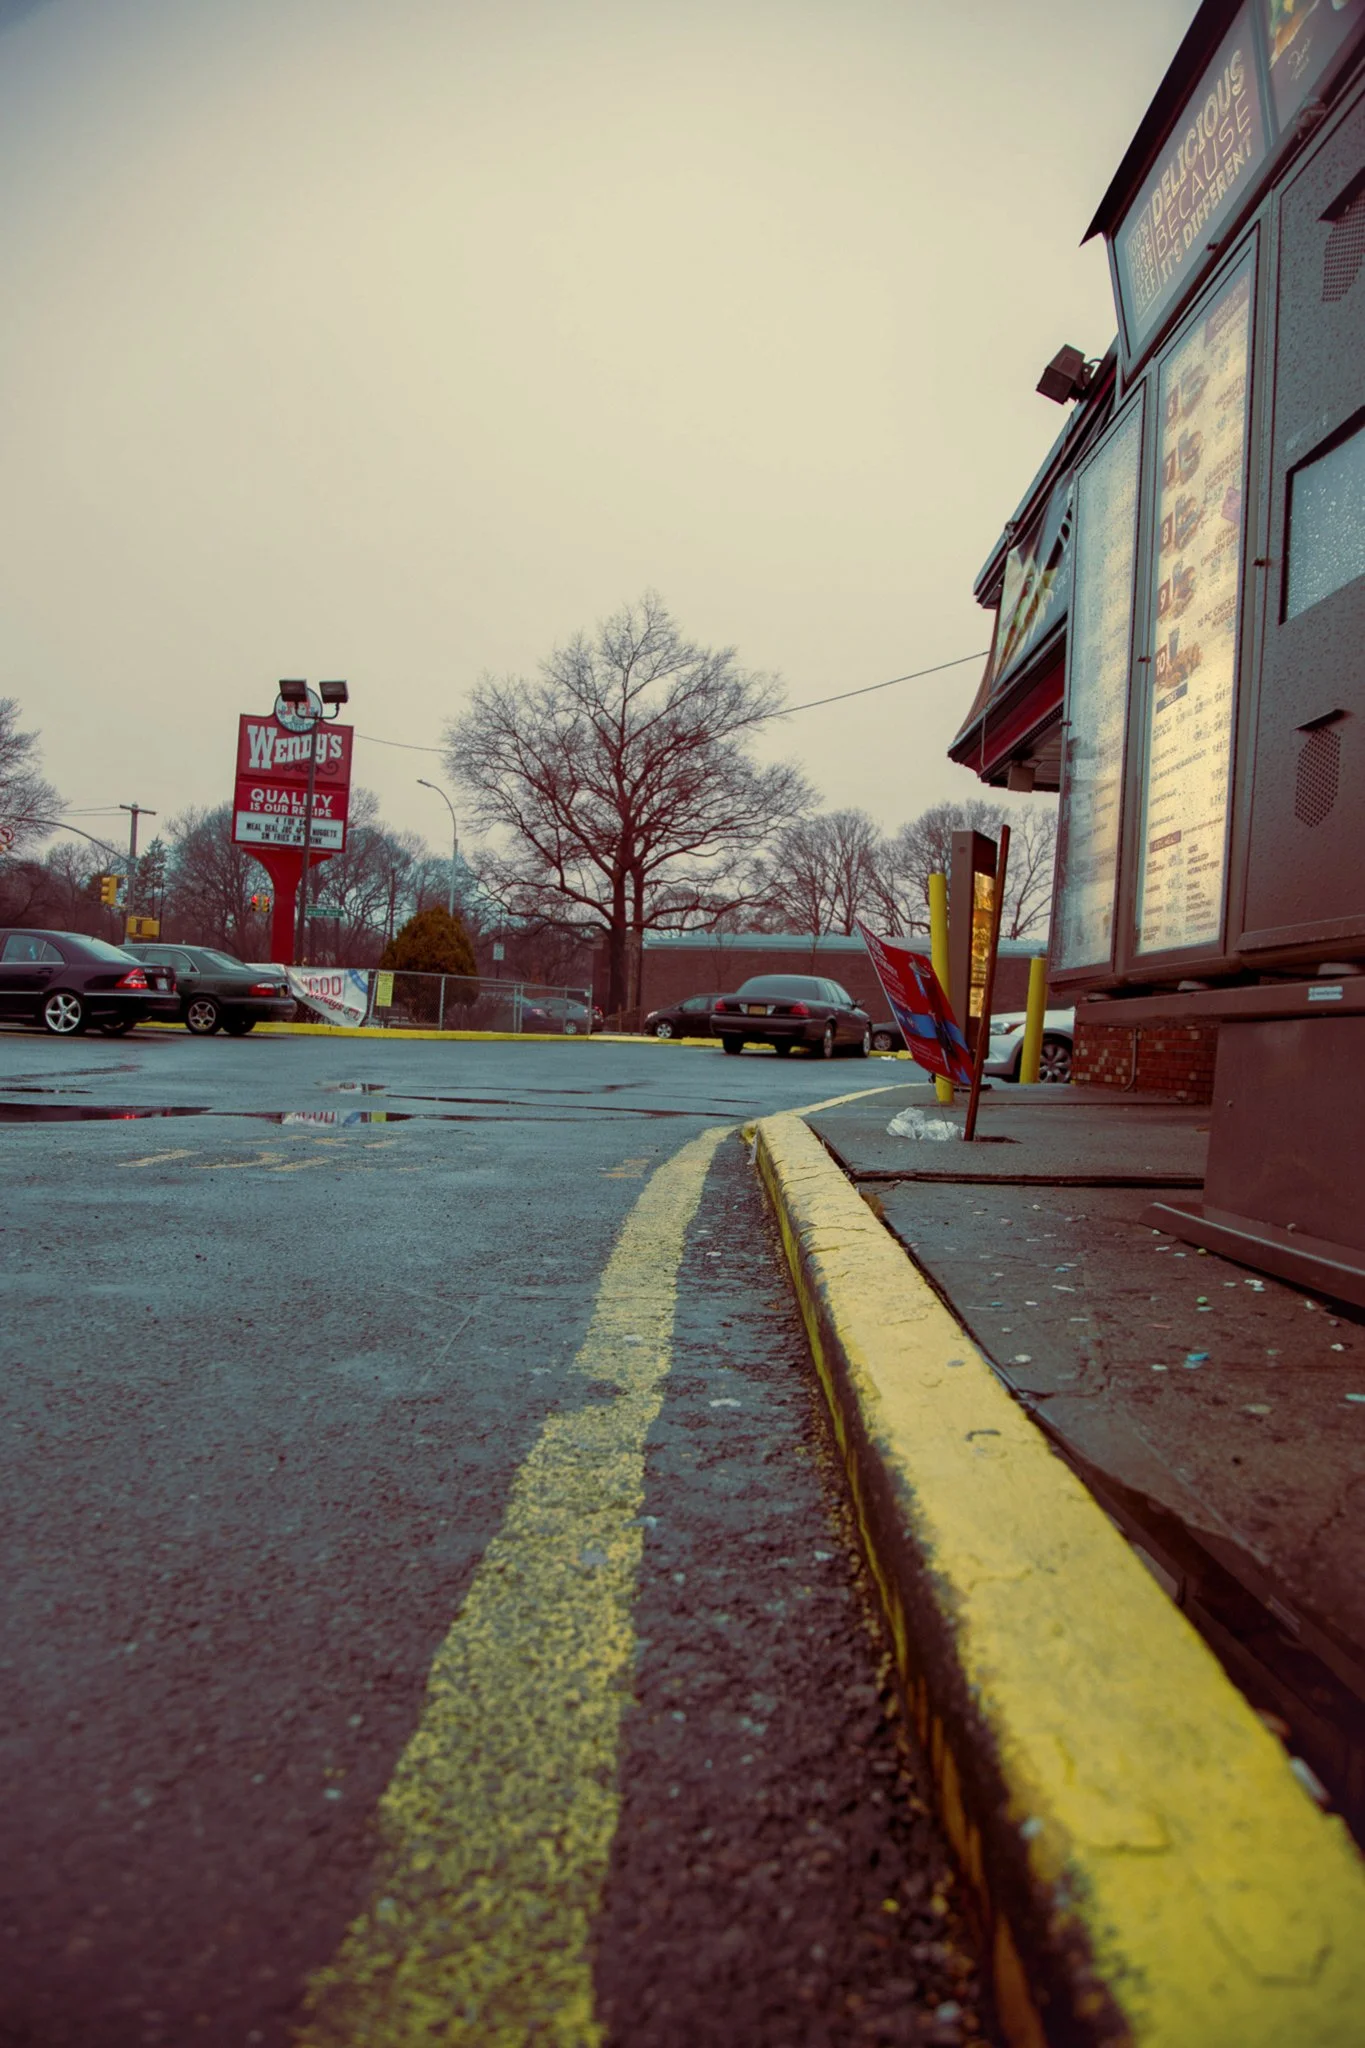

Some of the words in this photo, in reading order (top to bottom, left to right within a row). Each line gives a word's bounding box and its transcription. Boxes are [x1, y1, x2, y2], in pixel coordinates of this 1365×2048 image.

[1151, 49, 1245, 228] DELICIOUS
[1155, 89, 1250, 258] BECAUSE
[1182, 127, 1252, 250] DIFFERENT
[251, 788, 333, 808] QUALITY
[249, 802, 261, 811] IS
[264, 803, 288, 814] OUR
[291, 806, 332, 817] REIPE
[246, 822, 261, 831] MEAL
[265, 824, 278, 833] DEAL
[312, 829, 338, 838] NUGGETS
[274, 833, 289, 842] FRIES
